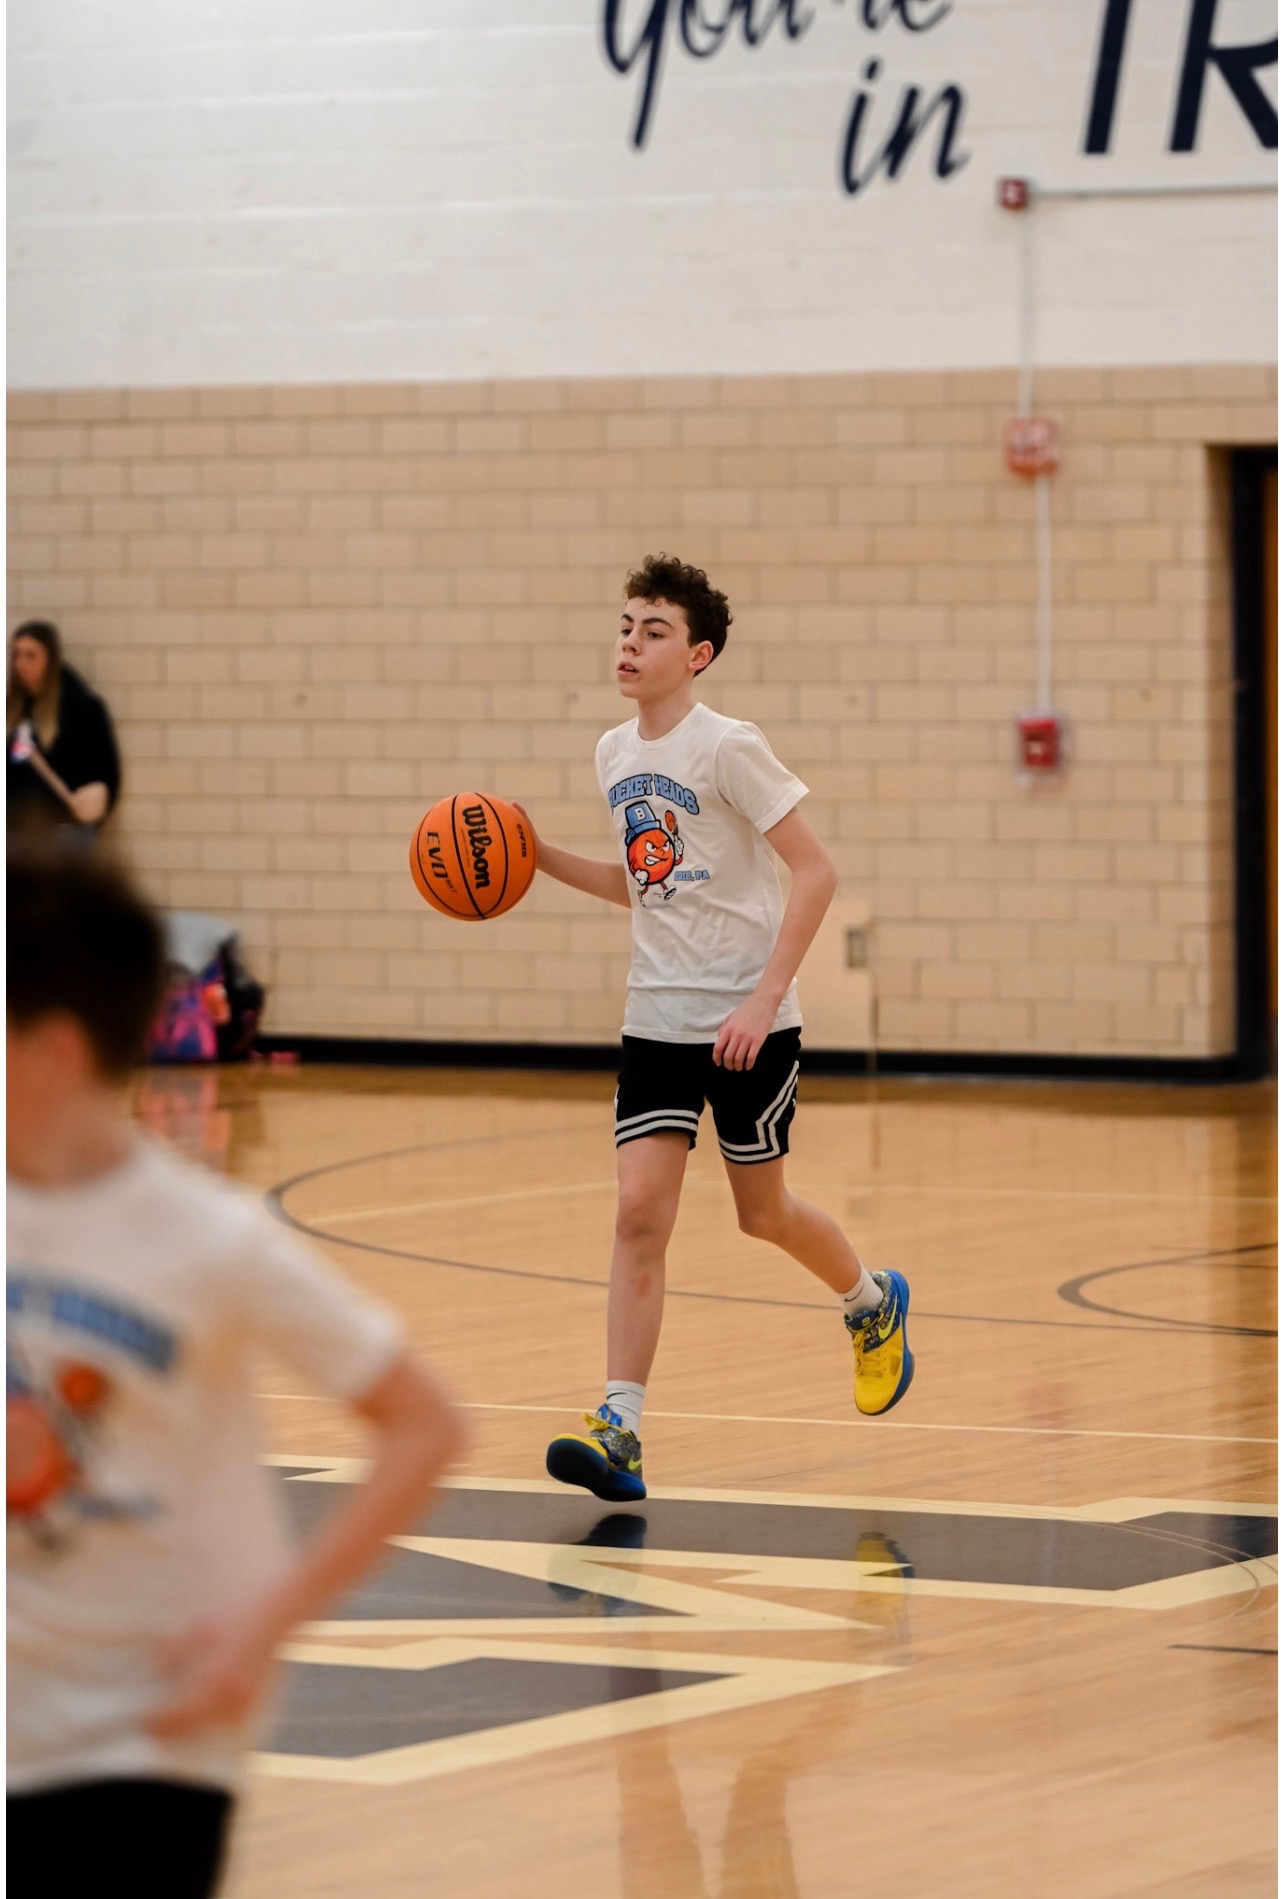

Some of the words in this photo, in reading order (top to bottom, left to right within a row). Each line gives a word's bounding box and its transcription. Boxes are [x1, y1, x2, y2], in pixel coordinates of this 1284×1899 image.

[840, 57, 969, 195] in
[634, 807, 647, 821] B
[653, 773, 700, 815] HEADS
[427, 832, 449, 878] EVO
[462, 804, 492, 889] Wilson
[694, 869, 710, 881] PA
